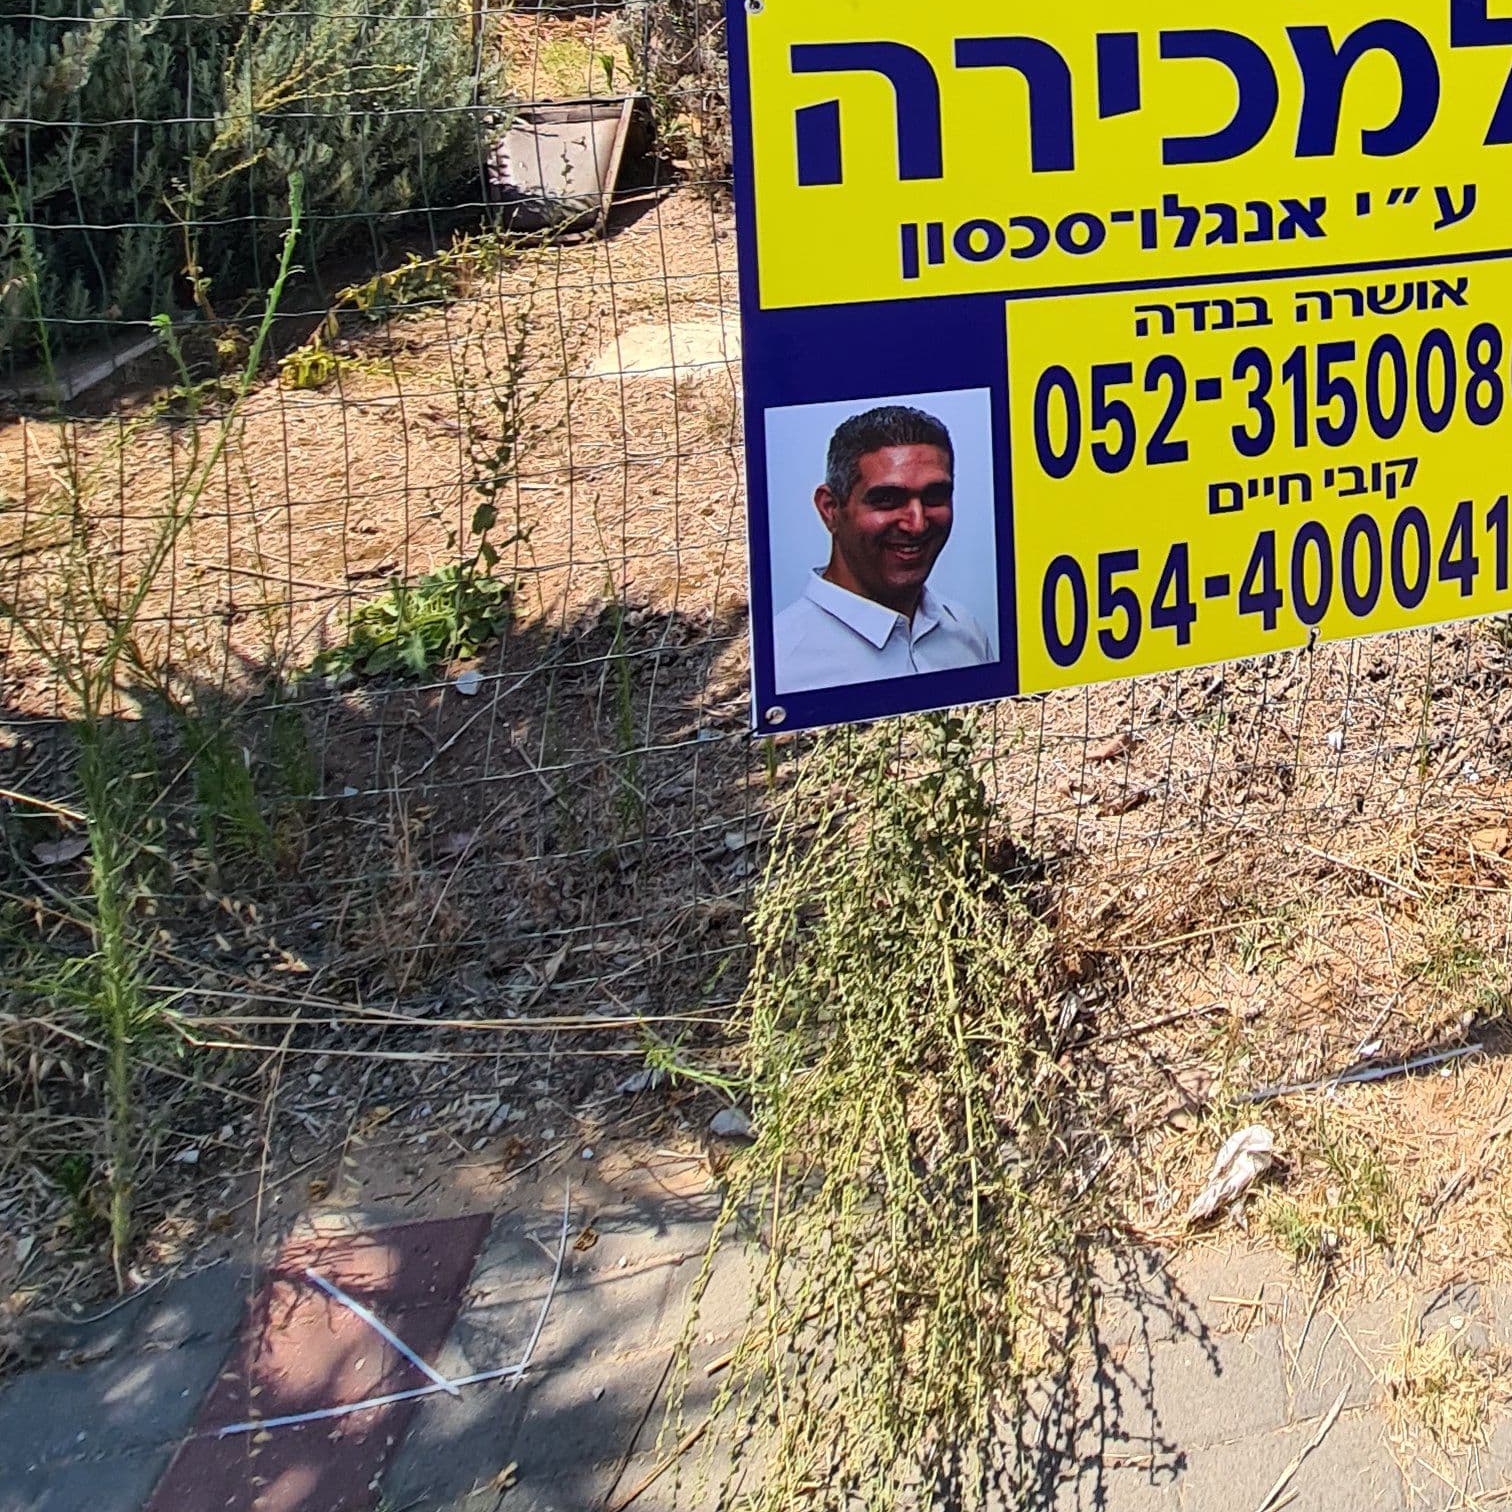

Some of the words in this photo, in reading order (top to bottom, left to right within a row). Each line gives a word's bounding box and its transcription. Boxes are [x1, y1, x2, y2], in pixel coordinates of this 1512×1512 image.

[900, 194, 1327, 280] אנגלו-סכסון
[1134, 295, 1273, 338] בנדה
[1295, 276, 1469, 324] אושרה
[1207, 473, 1313, 515] חיים
[1323, 456, 1419, 500] קובי
